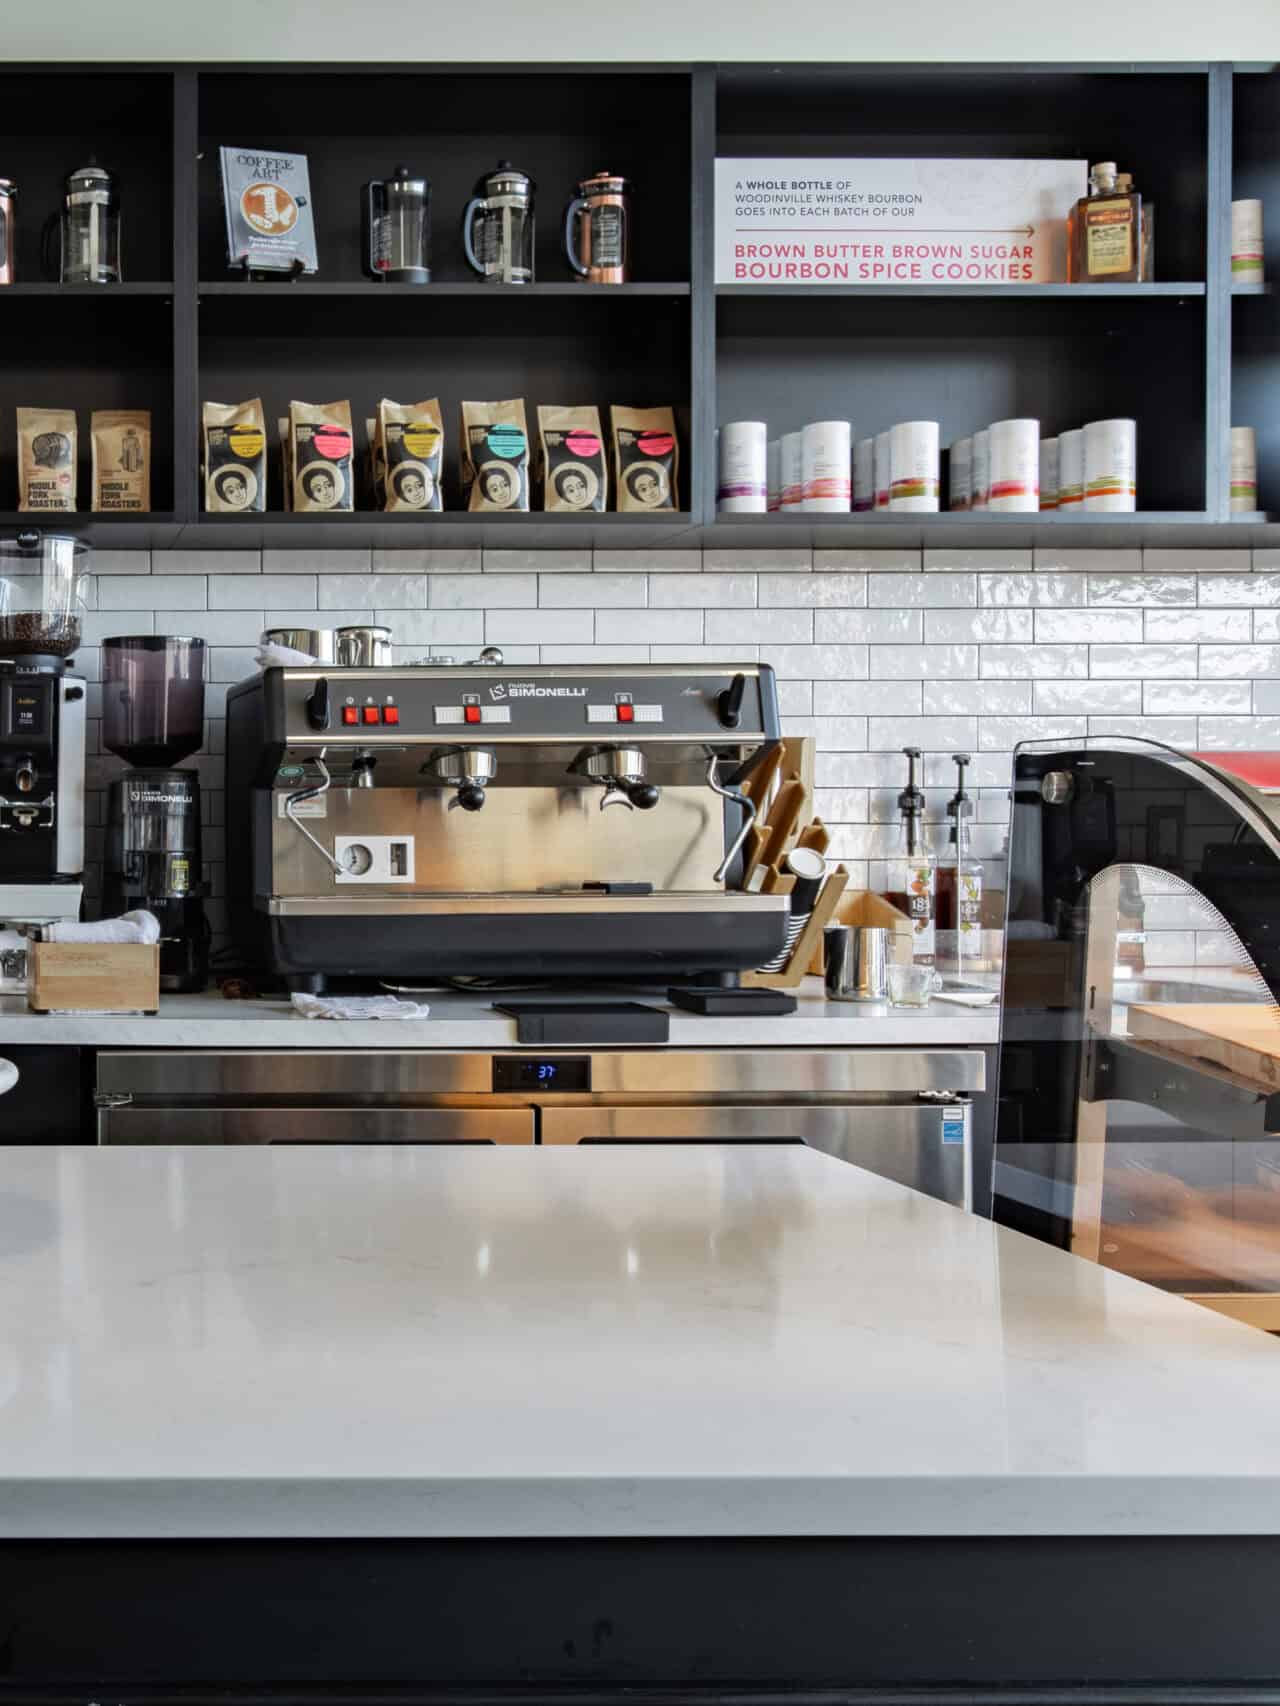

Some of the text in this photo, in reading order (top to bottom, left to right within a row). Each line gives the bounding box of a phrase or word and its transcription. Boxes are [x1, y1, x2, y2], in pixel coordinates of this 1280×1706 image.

[238, 155, 295, 170] COFFEE
[253, 168, 282, 180] ART
[735, 181, 853, 190] A WHOLE BOTTLE OF
[735, 194, 922, 204] WOODINVILLE WHISKEY BOURBON
[735, 207, 915, 216] GOES INTO EACH BATCH OF OUR
[735, 244, 1034, 259] BROWN BUTTER BROWN SUGAR
[735, 263, 1033, 280] BOURBON SPICE COOKIES
[508, 687, 586, 697] SIMONELLI
[538, 1065, 554, 1078] 37
